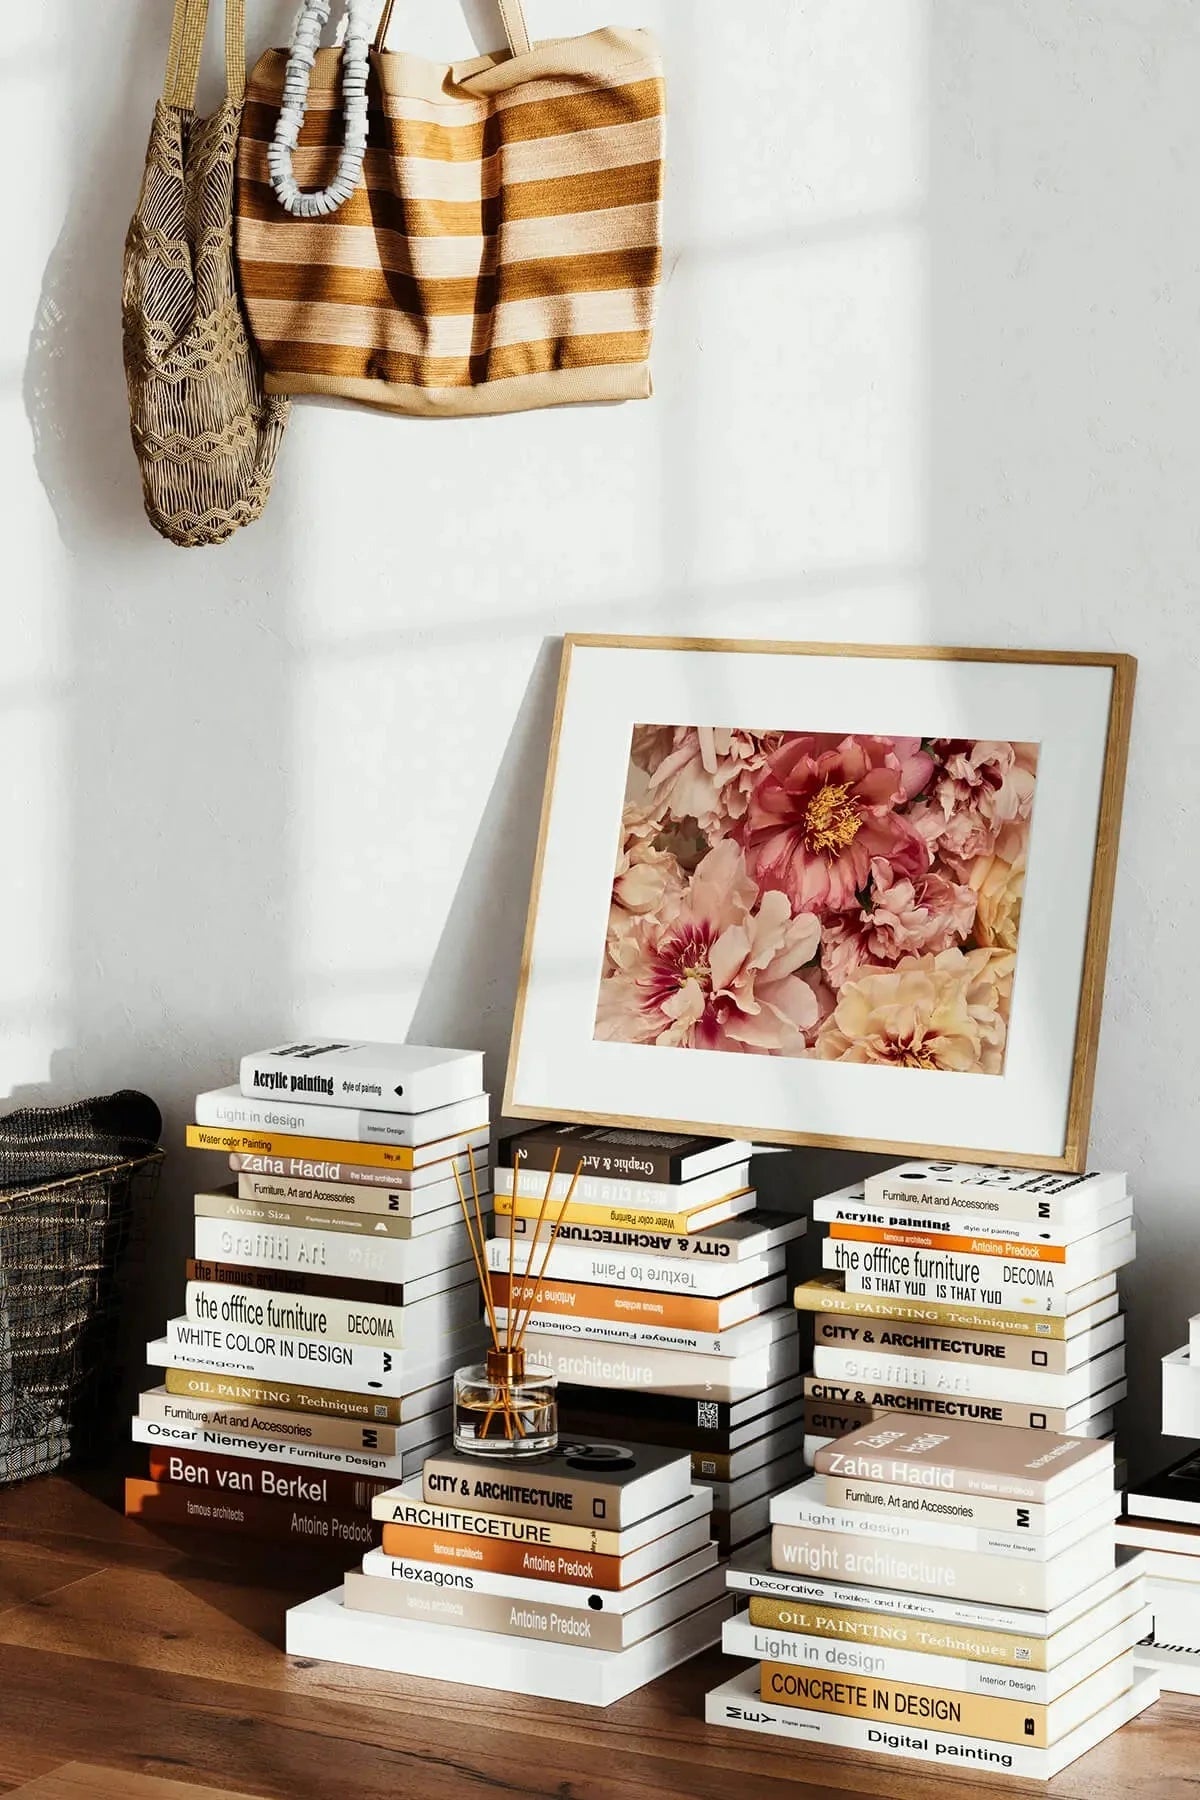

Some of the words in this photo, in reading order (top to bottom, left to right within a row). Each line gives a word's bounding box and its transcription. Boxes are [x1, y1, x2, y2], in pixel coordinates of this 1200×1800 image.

[253, 1070, 288, 1089] Acrylic
[290, 1074, 334, 1095] painting
[355, 1081, 360, 1092] of
[361, 1082, 382, 1096] painting
[216, 1106, 245, 1122] Light
[249, 1110, 261, 1122] in
[264, 1112, 305, 1129] design
[367, 1124, 386, 1133] Interior
[386, 1127, 405, 1136] Design
[199, 1133, 221, 1145] Water
[222, 1136, 241, 1147] color
[242, 1136, 272, 1152] Painting
[240, 1154, 284, 1175] Zaha
[290, 1158, 341, 1180] Hadid
[582, 1155, 601, 1165] Art
[603, 1157, 612, 1167] &
[613, 1158, 654, 1176] Graphic
[350, 1172, 360, 1180] the
[254, 1182, 286, 1197] Furniture,
[287, 1185, 299, 1198] Art
[298, 1187, 313, 1200] and
[313, 1190, 355, 1204] Accessories
[883, 1190, 920, 1205] Furniture,
[921, 1193, 933, 1206] Art
[933, 1194, 950, 1207] and
[950, 1197, 999, 1212] Accessories
[267, 1209, 292, 1221] Siza
[610, 1210, 636, 1225] Painting
[637, 1216, 656, 1226] color
[655, 1217, 675, 1230] Water
[835, 1210, 885, 1224] Acrylic
[889, 1214, 951, 1232] painting
[551, 1225, 672, 1250] ARCHITECTURE
[883, 1231, 905, 1243] famous
[905, 1234, 932, 1246] architects
[991, 1227, 1020, 1237] painting
[220, 1231, 289, 1261] Graffiti
[296, 1240, 327, 1265] Art
[677, 1238, 689, 1252] &
[692, 1241, 730, 1257] CITY
[971, 1239, 1004, 1255] Antoine
[1005, 1243, 1040, 1258] Predock
[194, 1262, 212, 1281] the
[214, 1263, 253, 1286] famous
[592, 1261, 626, 1279] Paint
[631, 1264, 643, 1280] to
[834, 1244, 859, 1270] the
[913, 1250, 980, 1284] furniture
[648, 1266, 697, 1289] Texture
[1003, 1265, 1054, 1288] DECOMA
[544, 1289, 576, 1306] Antoine
[861, 1276, 872, 1290] IS
[874, 1277, 901, 1295] THAT
[936, 1283, 947, 1299] IS
[950, 1286, 977, 1302] THAT
[195, 1289, 218, 1320] the
[267, 1299, 327, 1334] furniture
[821, 1298, 850, 1312] OIL
[855, 1300, 938, 1321] PAINTING
[348, 1314, 395, 1338] DECOMA
[584, 1326, 638, 1340] Furniture
[946, 1312, 1030, 1332] Techniques
[177, 1326, 222, 1348] WHITE
[225, 1332, 276, 1356] COLOR
[280, 1339, 294, 1358] IN
[298, 1342, 353, 1366] DESIGN
[640, 1334, 697, 1348] Niemeyer
[822, 1324, 860, 1342] CITY
[863, 1330, 875, 1343] &
[880, 1331, 1006, 1359] ARCHITECTURE
[173, 1353, 255, 1371] Hexagons
[558, 1355, 653, 1384] architecture
[843, 1360, 927, 1387] Graffiti
[935, 1368, 972, 1392] Art
[188, 1380, 214, 1394] OIL
[217, 1383, 291, 1404] PAINTING
[811, 1384, 849, 1402] CITY
[853, 1390, 866, 1404] &
[872, 1391, 1003, 1422] ARCHITECTURE
[297, 1394, 369, 1415] Techniques
[164, 1405, 211, 1425] Furniture,
[213, 1411, 228, 1425] Art
[229, 1413, 249, 1428] and
[250, 1415, 312, 1437] Accessories
[812, 1414, 849, 1430] CITY
[147, 1423, 198, 1441] Oscar
[203, 1431, 286, 1454] Niemeyer
[853, 1431, 907, 1449] Zaha
[289, 1447, 342, 1462] Furniture
[345, 1455, 387, 1470] Design
[169, 1457, 208, 1485] Ben
[216, 1469, 253, 1491] van
[261, 1471, 327, 1502] Berkel
[828, 1453, 884, 1480] Zaha
[891, 1461, 955, 1490] Hadid
[428, 1474, 459, 1496] CITY
[460, 1478, 470, 1495] &
[474, 1480, 573, 1511] ARCHITECTURE
[845, 1488, 886, 1506] Furniture,
[887, 1495, 901, 1507] Art
[902, 1496, 920, 1511] and
[920, 1497, 974, 1518] Accessories
[187, 1500, 212, 1517] famous
[212, 1503, 245, 1522] architects
[290, 1512, 329, 1537] Antoine
[331, 1518, 373, 1544] Predock
[391, 1505, 552, 1544] ARCHITECETURE
[799, 1511, 835, 1527] Light
[841, 1517, 854, 1528] in
[859, 1520, 910, 1537] design
[433, 1542, 455, 1556] famous
[455, 1545, 483, 1561] architects
[391, 1560, 474, 1588] Hexagons
[523, 1552, 556, 1573] Antoine
[557, 1557, 594, 1579] Predock
[782, 1541, 839, 1572] wright
[845, 1551, 956, 1587] architecture
[749, 1576, 825, 1598] Decorative
[874, 1597, 895, 1608] and
[431, 1598, 464, 1617] architects
[509, 1607, 548, 1631] Antoine
[550, 1612, 592, 1638] Predock
[778, 1611, 810, 1626] OIL
[815, 1616, 908, 1642] PAINTING
[753, 1634, 800, 1657] Light
[804, 1642, 820, 1661] in
[825, 1645, 886, 1672] design
[916, 1631, 1008, 1657] Techniques
[979, 1674, 1007, 1687] Interior
[1008, 1678, 1036, 1692] Design
[771, 1673, 868, 1708] CONCRETE
[872, 1688, 890, 1711] IN
[894, 1693, 962, 1723] DESIGN
[867, 1729, 929, 1751] Digital
[935, 1738, 1013, 1767] painting
